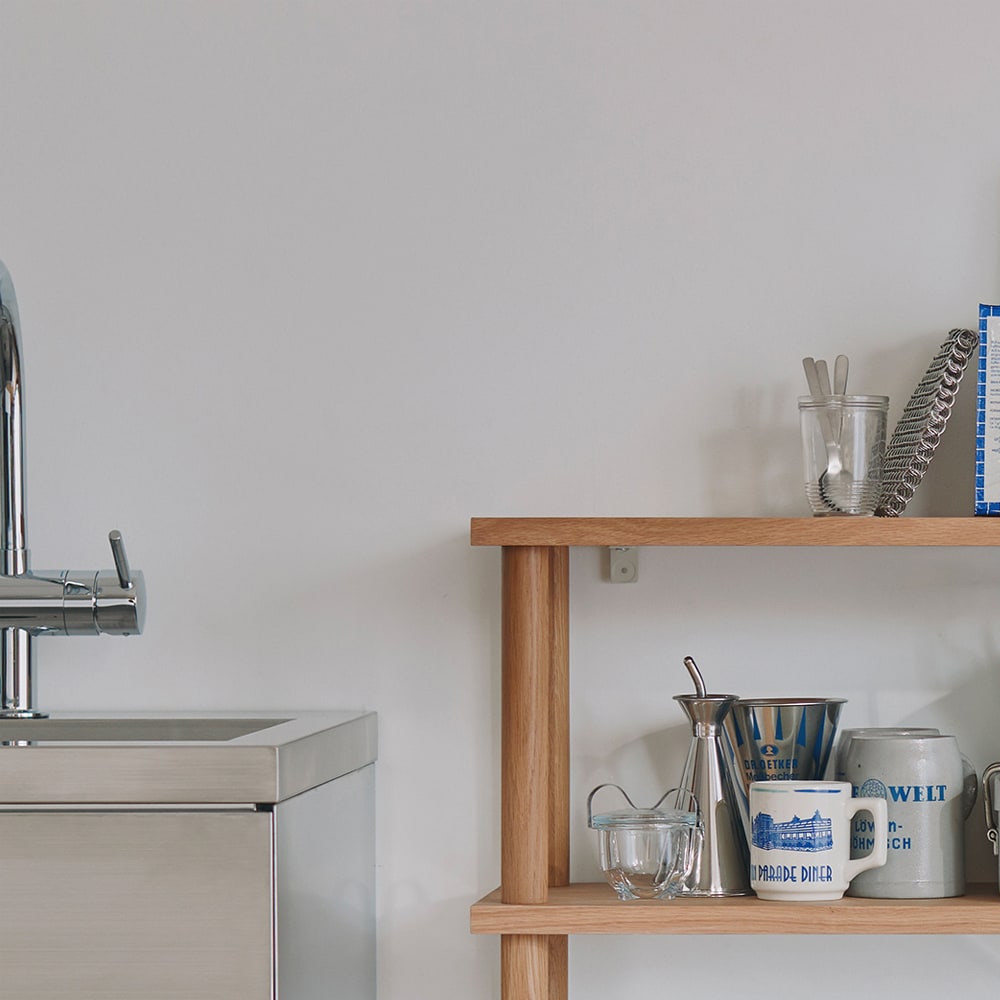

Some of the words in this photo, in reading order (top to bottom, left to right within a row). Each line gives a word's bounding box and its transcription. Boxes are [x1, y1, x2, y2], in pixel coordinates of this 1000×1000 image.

[888, 785, 947, 802] WELT
[758, 865, 798, 882] PARADE
[801, 865, 833, 882] DINER
